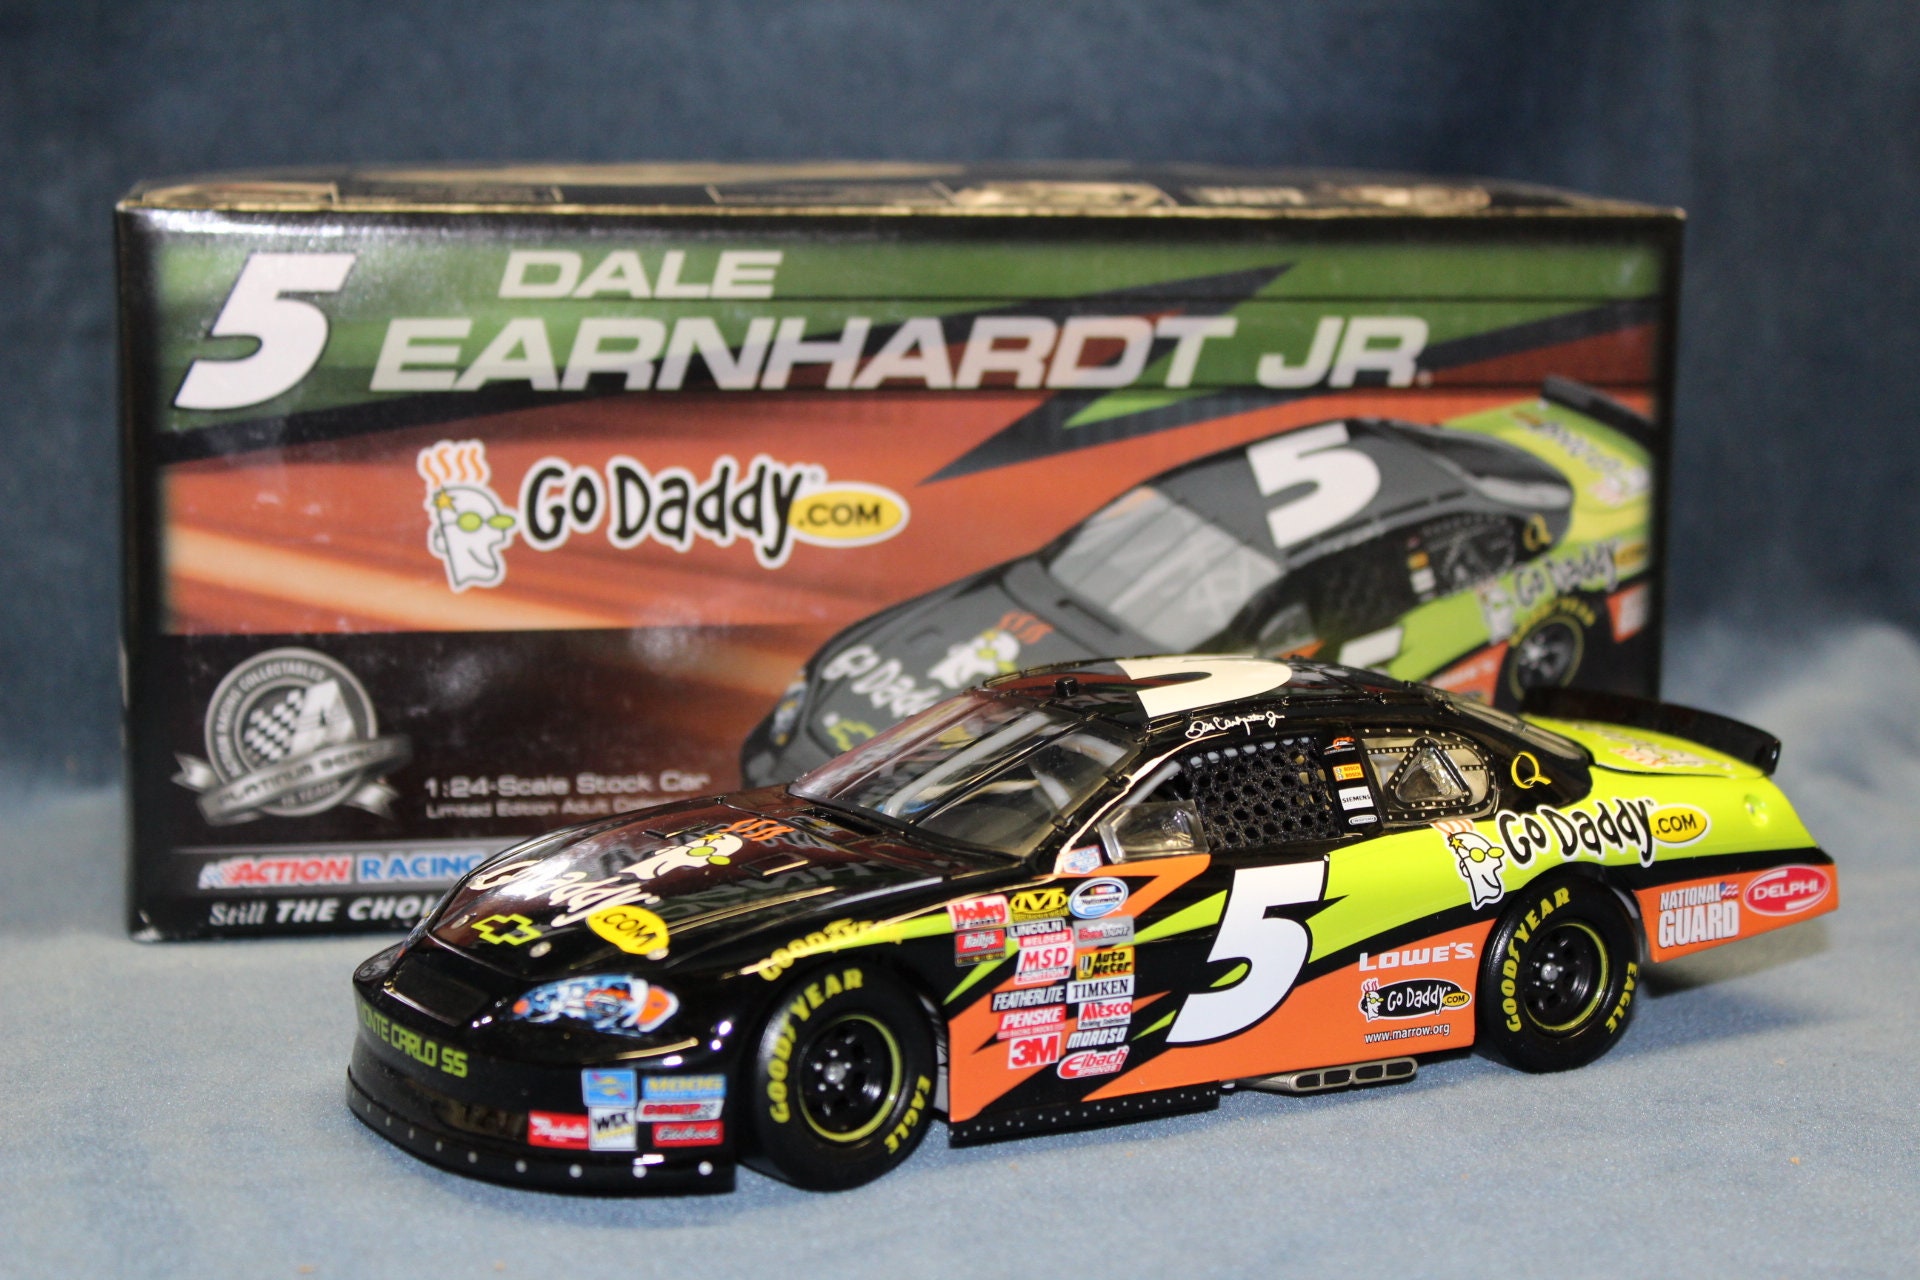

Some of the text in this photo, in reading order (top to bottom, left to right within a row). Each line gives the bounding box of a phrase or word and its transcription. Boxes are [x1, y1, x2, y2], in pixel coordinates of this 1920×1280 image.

[499, 250, 782, 299] DALE
[174, 252, 356, 410] 5
[369, 316, 1237, 391] EARNHARDT
[1247, 421, 1382, 550] 5
[576, 771, 651, 795] Stock
[659, 768, 710, 792] Car
[425, 802, 493, 819] Limited
[496, 798, 557, 817] Edition
[1342, 794, 1372, 803] SIEMENS
[229, 856, 351, 884] ACTION
[1659, 882, 1722, 909] NATIONAL
[1753, 876, 1821, 900] DELPHI
[209, 902, 268, 926] Still
[275, 899, 340, 924] THE
[1658, 901, 1738, 949] GUARD
[1010, 920, 1062, 937] LINCOLN
[1021, 946, 1068, 971] MSD
[1095, 951, 1125, 962] Auto
[1166, 860, 1327, 1044] 5
[1359, 942, 1475, 971] LOWE'S
[992, 986, 1065, 1011] FEATHERLITE
[1073, 979, 1129, 999] TIMKEN
[1605, 961, 1639, 1035] EAGLE
[1001, 1007, 1063, 1030] PENSKE
[1066, 1027, 1128, 1049] MOROSO
[1364, 1023, 1451, 1044] www.marrow.org
[391, 1022, 438, 1068] CARLO
[441, 1046, 469, 1079] SS
[1012, 1035, 1059, 1066] 3M
[884, 1074, 932, 1155] EAGLE
